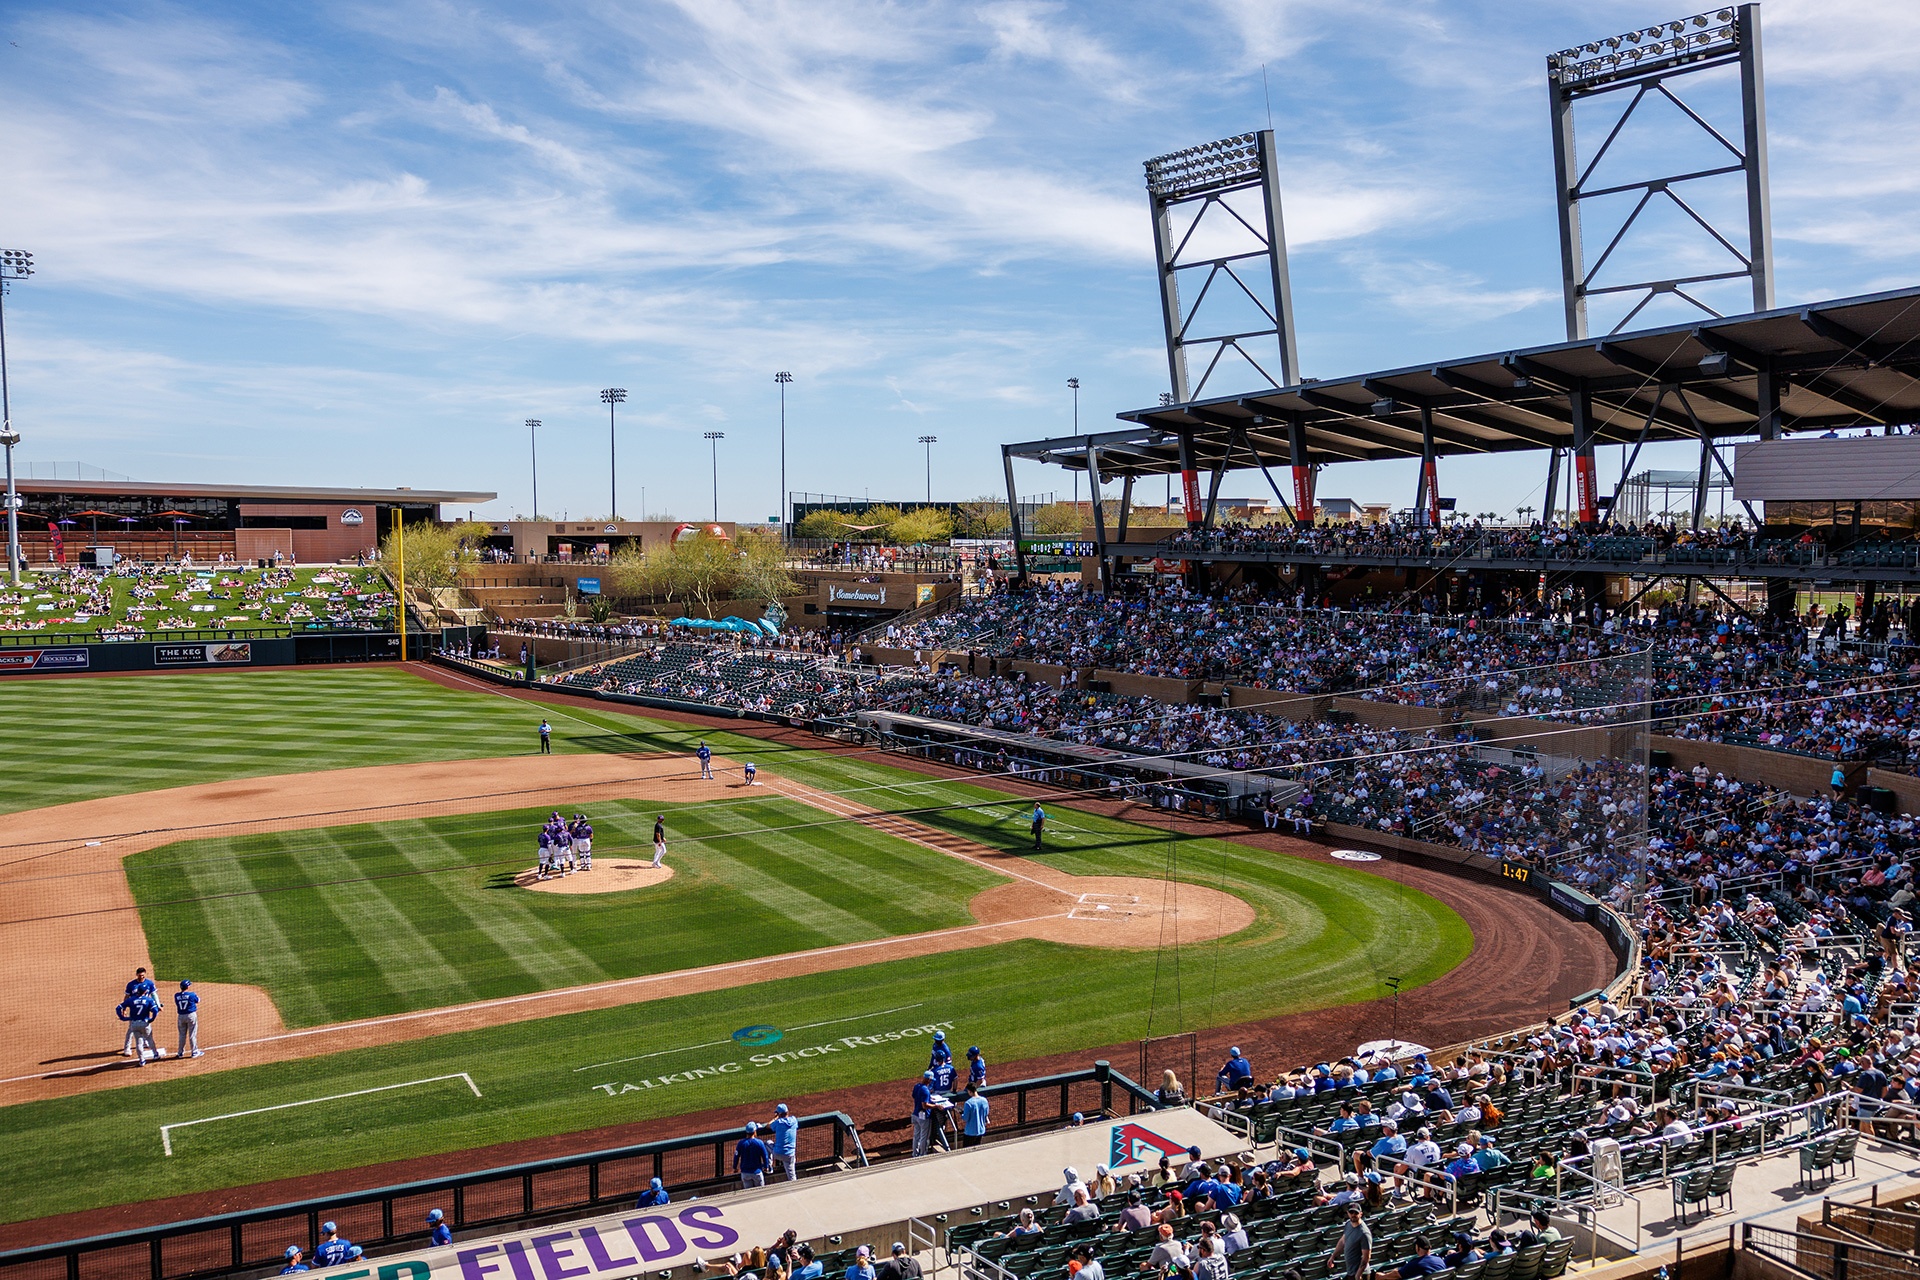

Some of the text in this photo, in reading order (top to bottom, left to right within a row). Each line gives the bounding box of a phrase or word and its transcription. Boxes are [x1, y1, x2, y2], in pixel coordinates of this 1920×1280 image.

[1578, 471, 1586, 510] SCHEELS
[51, 529, 64, 555] BAR
[836, 588, 880, 600] Someburros
[182, 648, 201, 656] KEG
[1502, 863, 1529, 882] 1:47
[136, 1004, 144, 1016] 7
[178, 1000, 189, 1010] 17
[591, 1021, 955, 1097] TALKING STICK RESORT
[940, 1074, 950, 1087] 15
[456, 1205, 740, 1280] FIELDS
